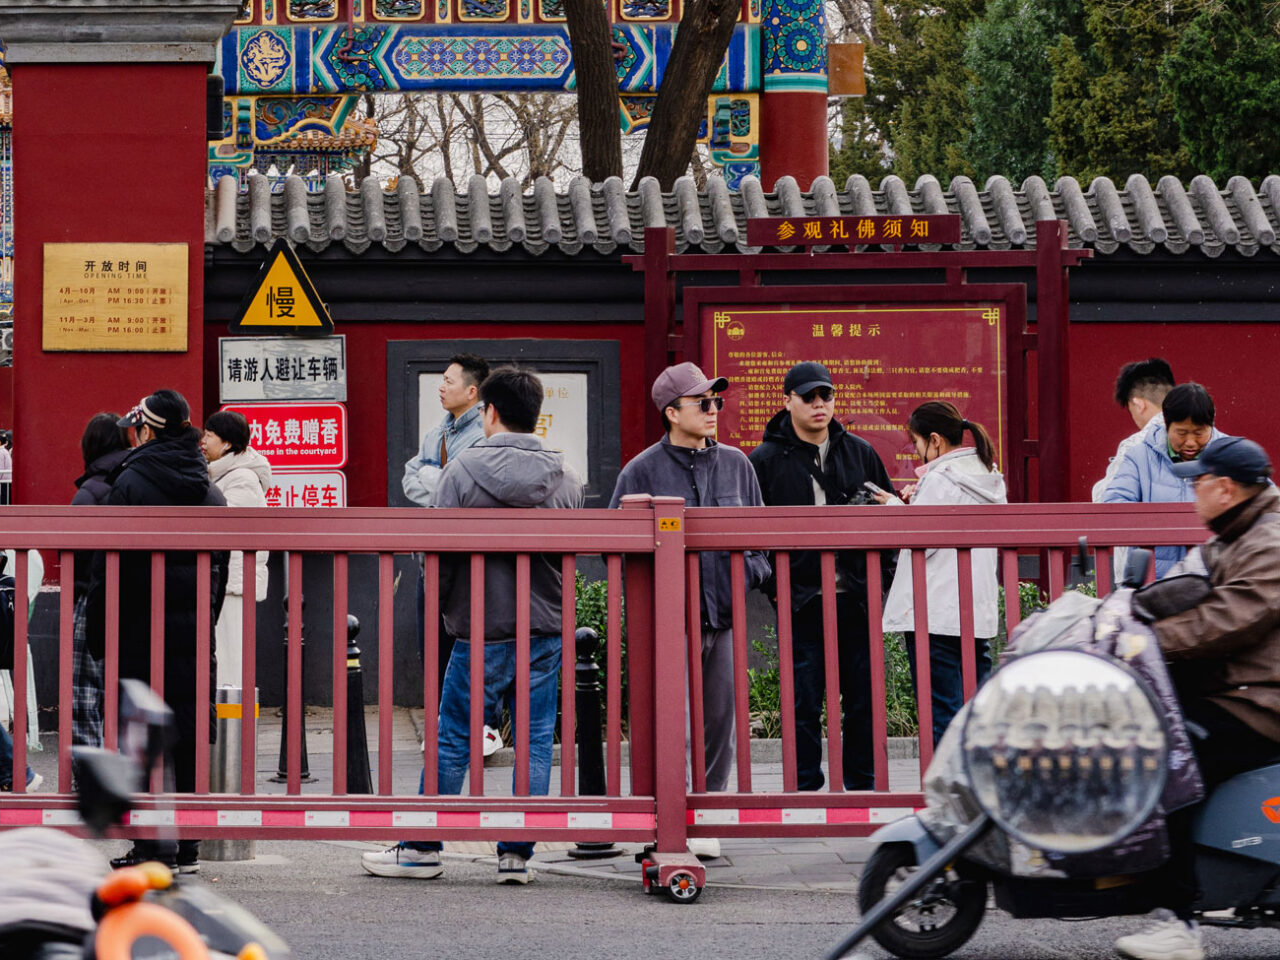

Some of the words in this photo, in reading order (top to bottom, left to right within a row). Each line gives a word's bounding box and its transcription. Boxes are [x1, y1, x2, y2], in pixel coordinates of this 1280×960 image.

[776, 219, 930, 240] 参观礼佛须知
[84, 260, 147, 272] 开放时间
[266, 286, 296, 318] 慢
[812, 323, 881, 337] 温馨提示
[228, 357, 338, 382] 请游人避让车辆
[300, 447, 336, 456] courtyard
[265, 484, 338, 507] 禁止停车
